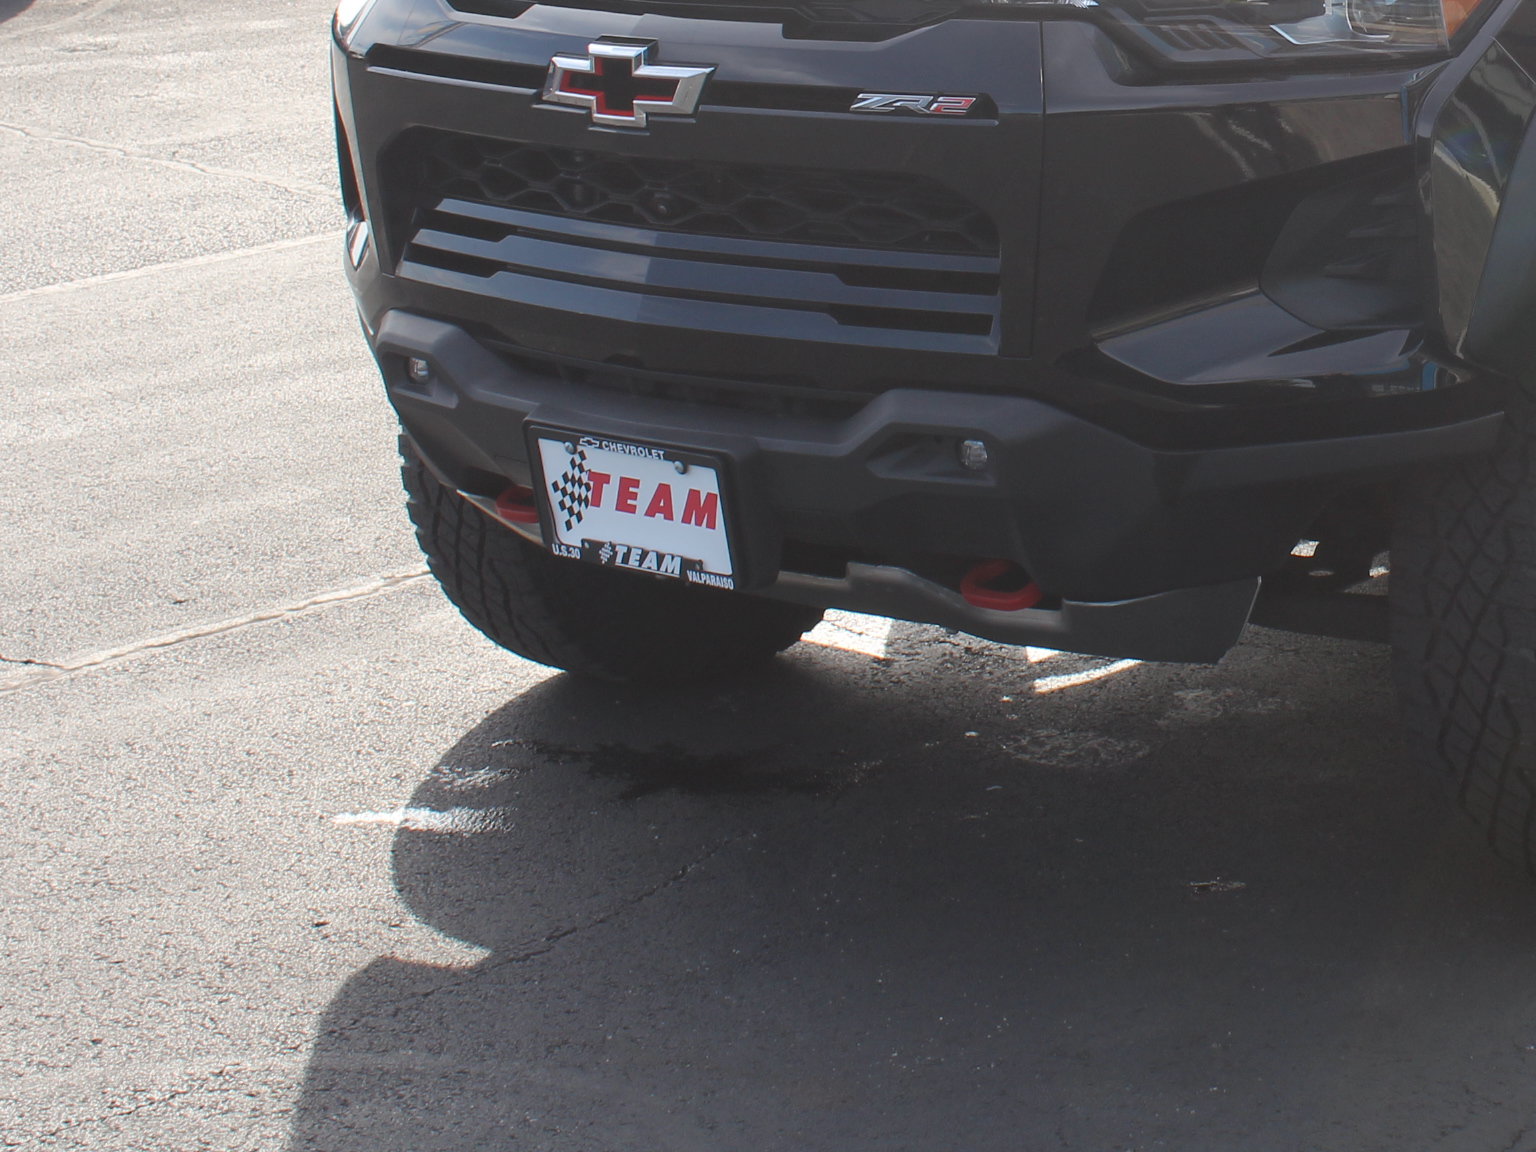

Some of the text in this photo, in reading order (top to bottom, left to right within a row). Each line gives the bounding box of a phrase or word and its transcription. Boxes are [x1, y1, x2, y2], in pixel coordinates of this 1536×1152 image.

[850, 93, 976, 115] ZR2
[601, 440, 665, 460] CHEVROLET
[587, 470, 718, 530] TEAM
[615, 544, 682, 576] TEAM
[686, 570, 734, 590] VALPARAISO
